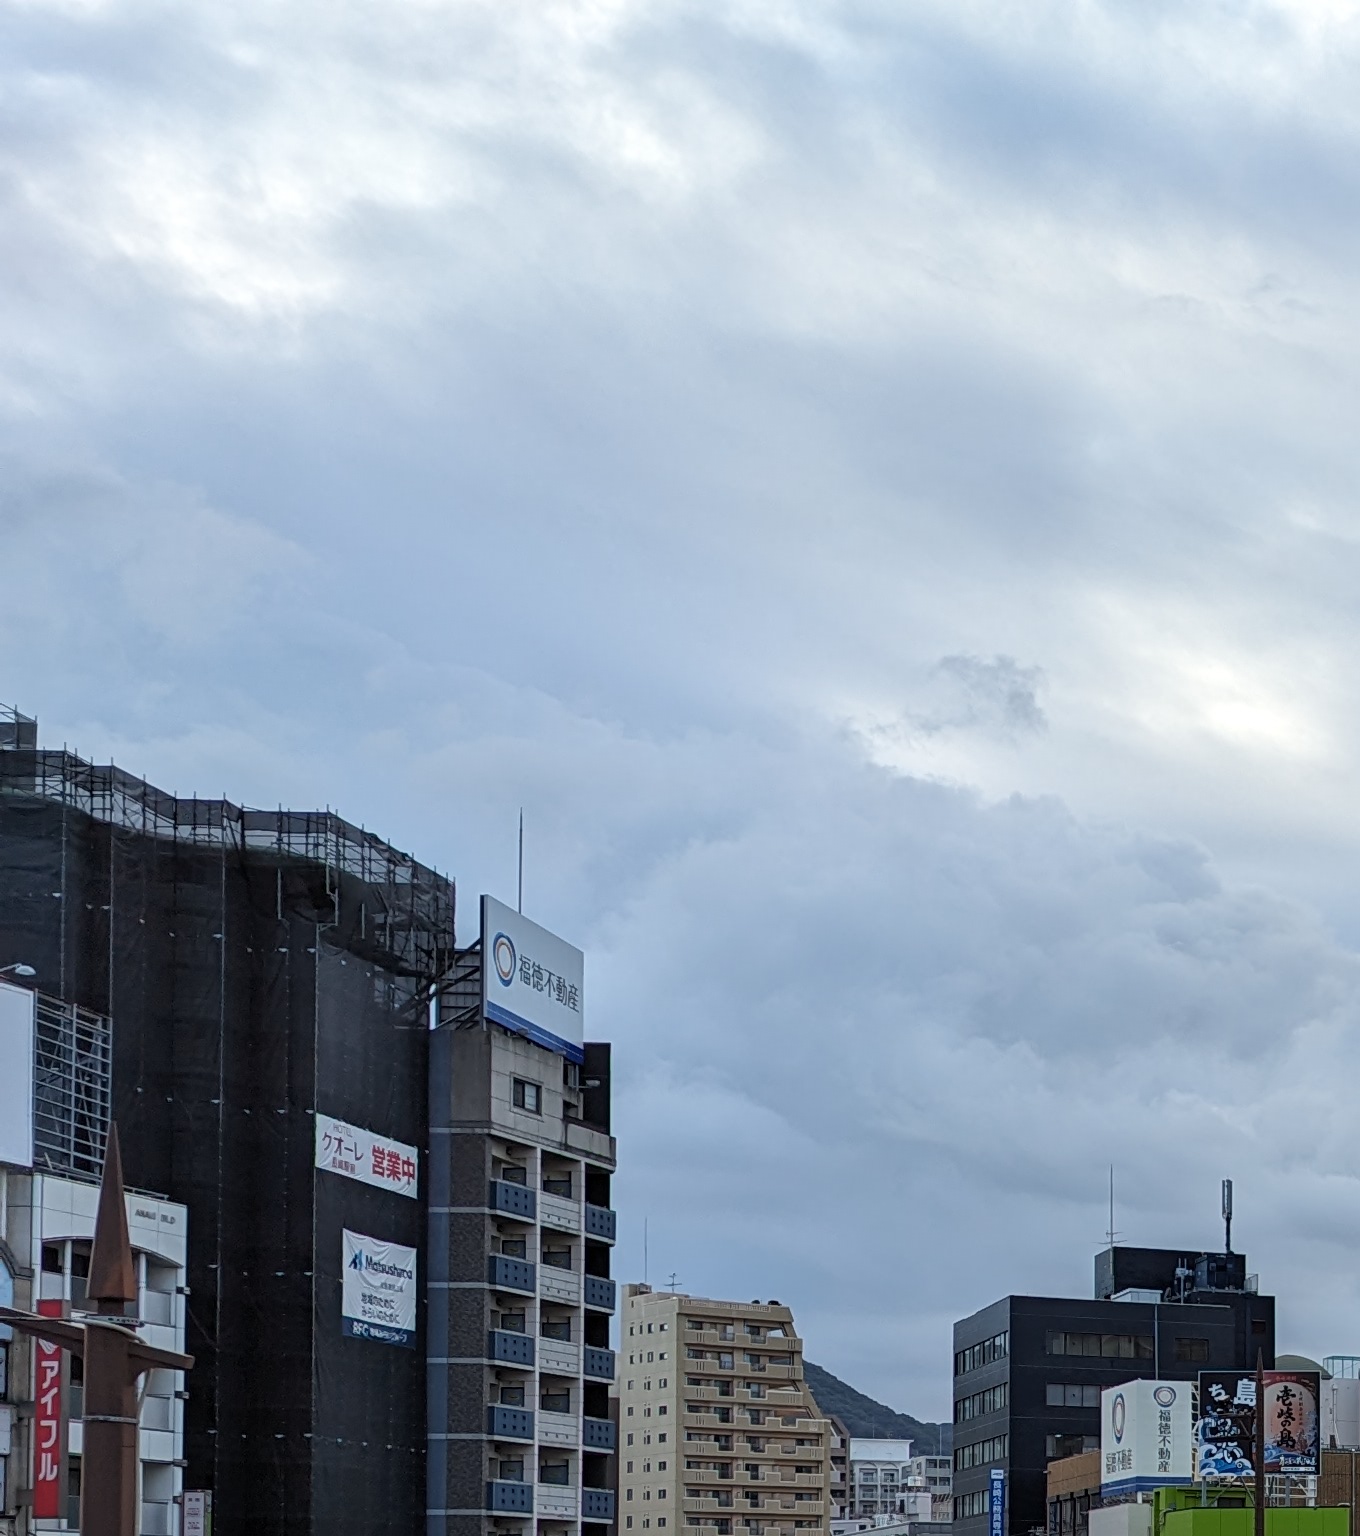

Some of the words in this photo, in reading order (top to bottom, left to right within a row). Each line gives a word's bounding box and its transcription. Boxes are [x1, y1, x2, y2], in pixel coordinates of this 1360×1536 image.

[519, 954, 580, 1013] 福徳不動産
[322, 1132, 364, 1161] クオーレ
[372, 1144, 416, 1186] 営業中
[38, 1360, 59, 1482] アイフル
[1157, 1409, 1172, 1473] 福徳不動産
[1276, 1385, 1297, 1448] 壱岐の島
